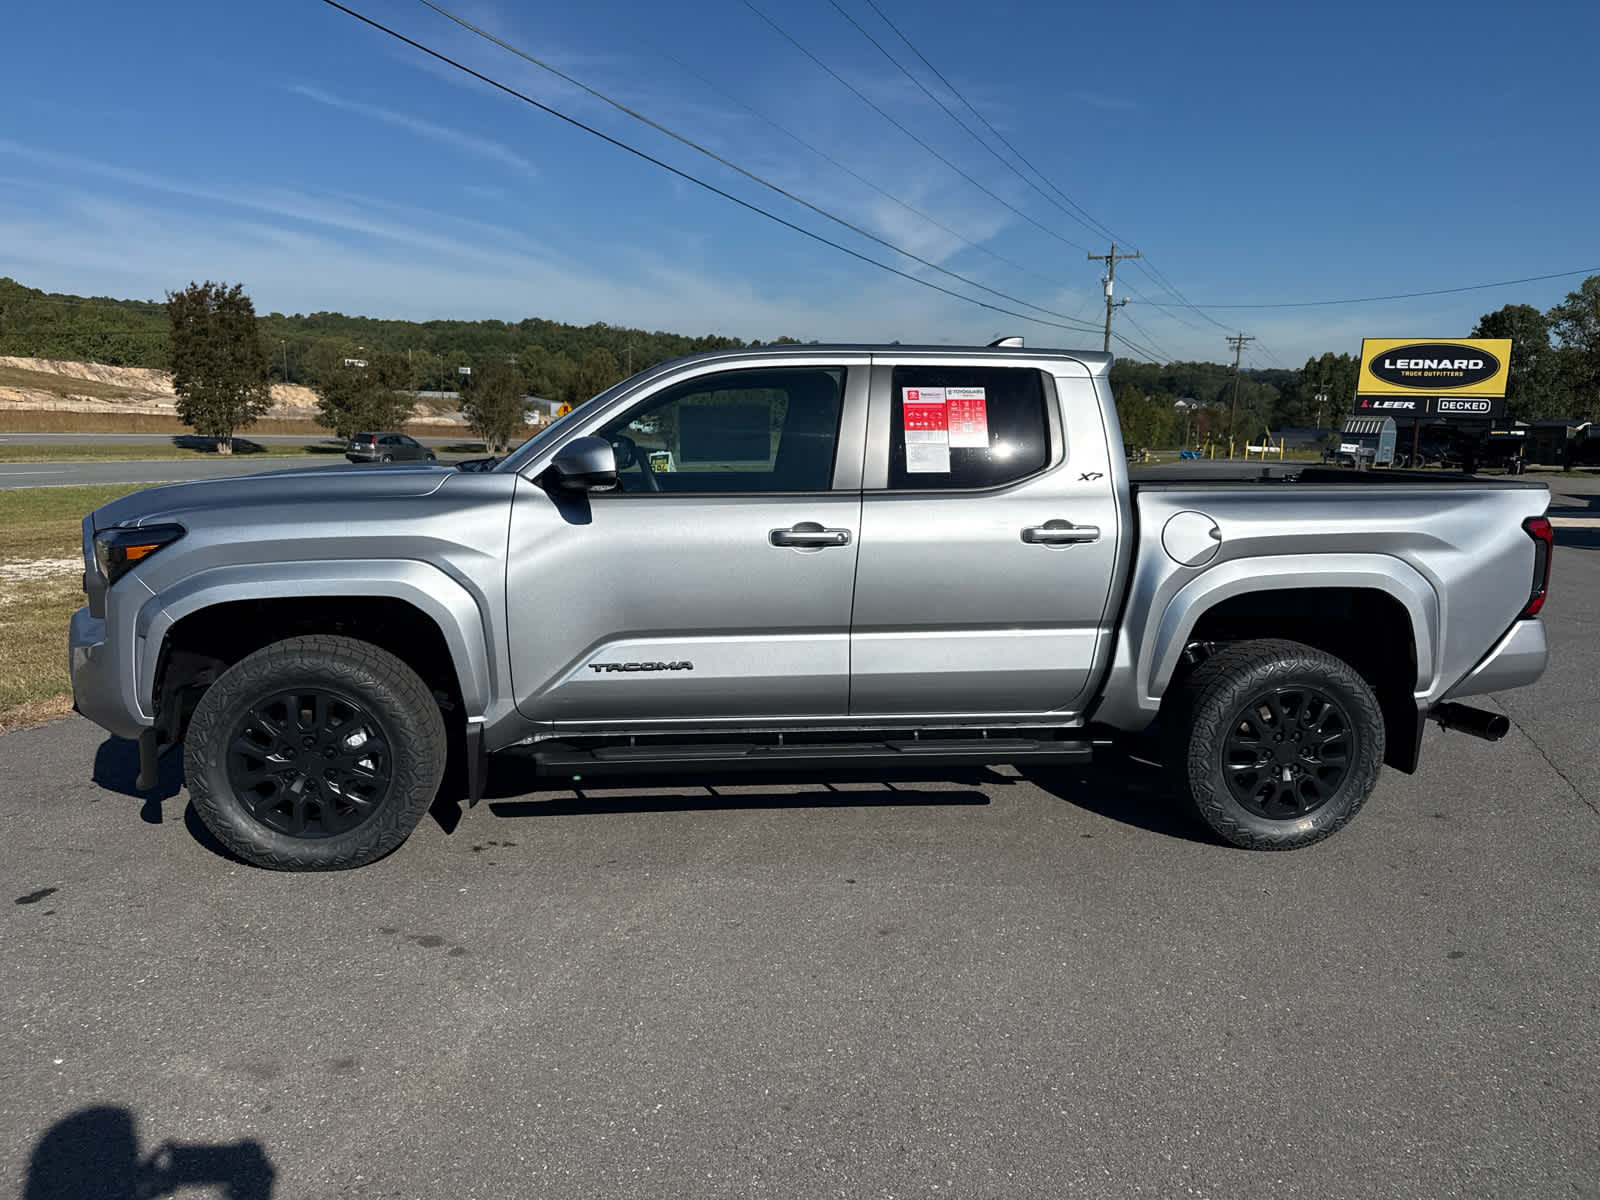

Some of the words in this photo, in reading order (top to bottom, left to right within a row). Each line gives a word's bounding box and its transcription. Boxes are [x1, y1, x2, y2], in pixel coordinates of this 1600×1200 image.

[1384, 359, 1484, 369] LEONARD
[1373, 401, 1416, 410] LEER
[1441, 402, 1488, 410] DECKED
[588, 661, 694, 673] TACOMA
